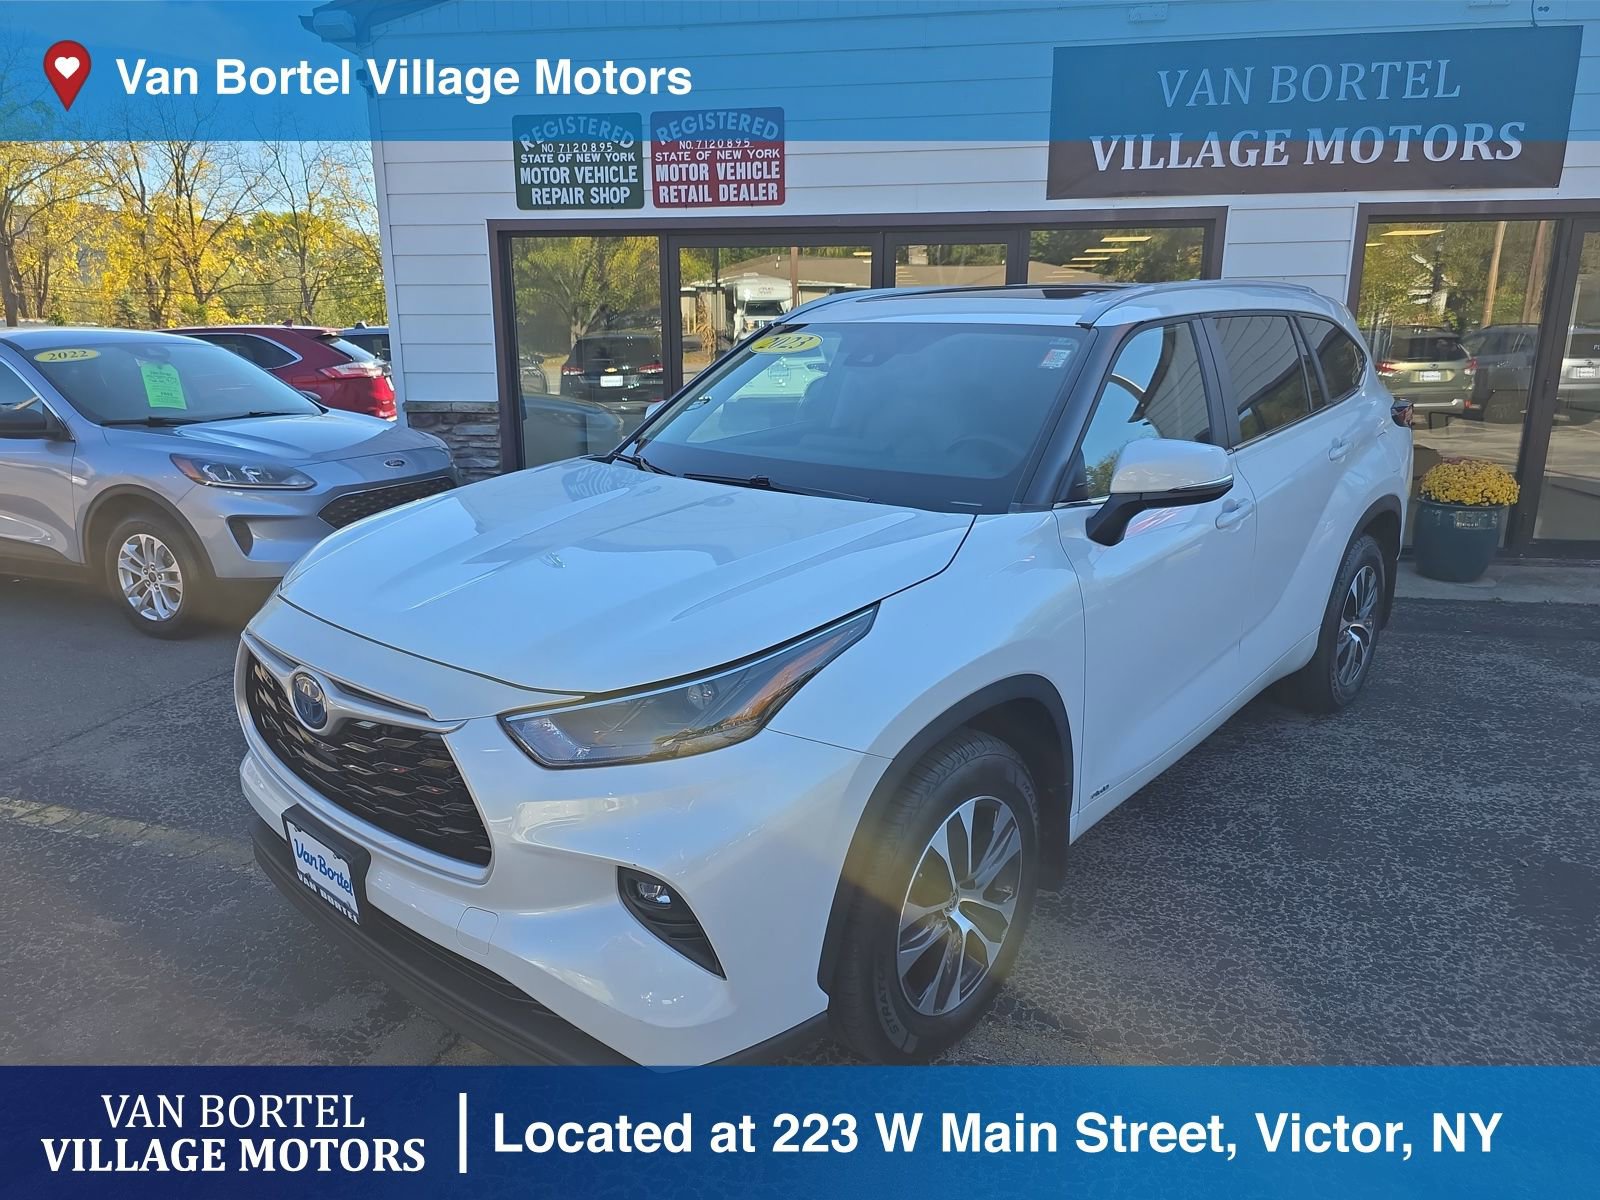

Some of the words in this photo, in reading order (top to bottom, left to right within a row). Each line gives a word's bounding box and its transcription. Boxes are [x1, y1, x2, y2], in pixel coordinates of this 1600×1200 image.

[1157, 66, 1255, 108] VAN
[1268, 59, 1461, 104] BORTEL
[519, 116, 635, 152] REGISTERED
[656, 111, 779, 146] REGISTERED
[541, 143, 556, 153] NO.
[558, 142, 613, 153] 7120895
[679, 140, 694, 150] NO.
[696, 138, 751, 149] 7120895
[1089, 128, 1292, 171] VILLAGE
[1303, 121, 1526, 165] MOTORS
[520, 153, 554, 164] STATE
[557, 153, 573, 163] OF
[576, 153, 601, 163] NEW
[604, 152, 636, 162] YORK
[655, 151, 691, 162] STATE
[696, 150, 712, 161] OF
[716, 149, 742, 160] NEW
[747, 148, 781, 159] YORK
[520, 166, 571, 185] MOTOR
[574, 165, 639, 184] VEHICLE
[655, 163, 710, 182] MOTOR
[716, 160, 780, 180] VEHICLE
[531, 187, 585, 205] REPAIR
[590, 186, 631, 205] SHOP
[658, 184, 713, 204] RETAIL
[718, 182, 778, 202] DEALER
[47, 350, 89, 362] 2022
[294, 838, 319, 871] Van
[318, 854, 354, 897] Bortel
